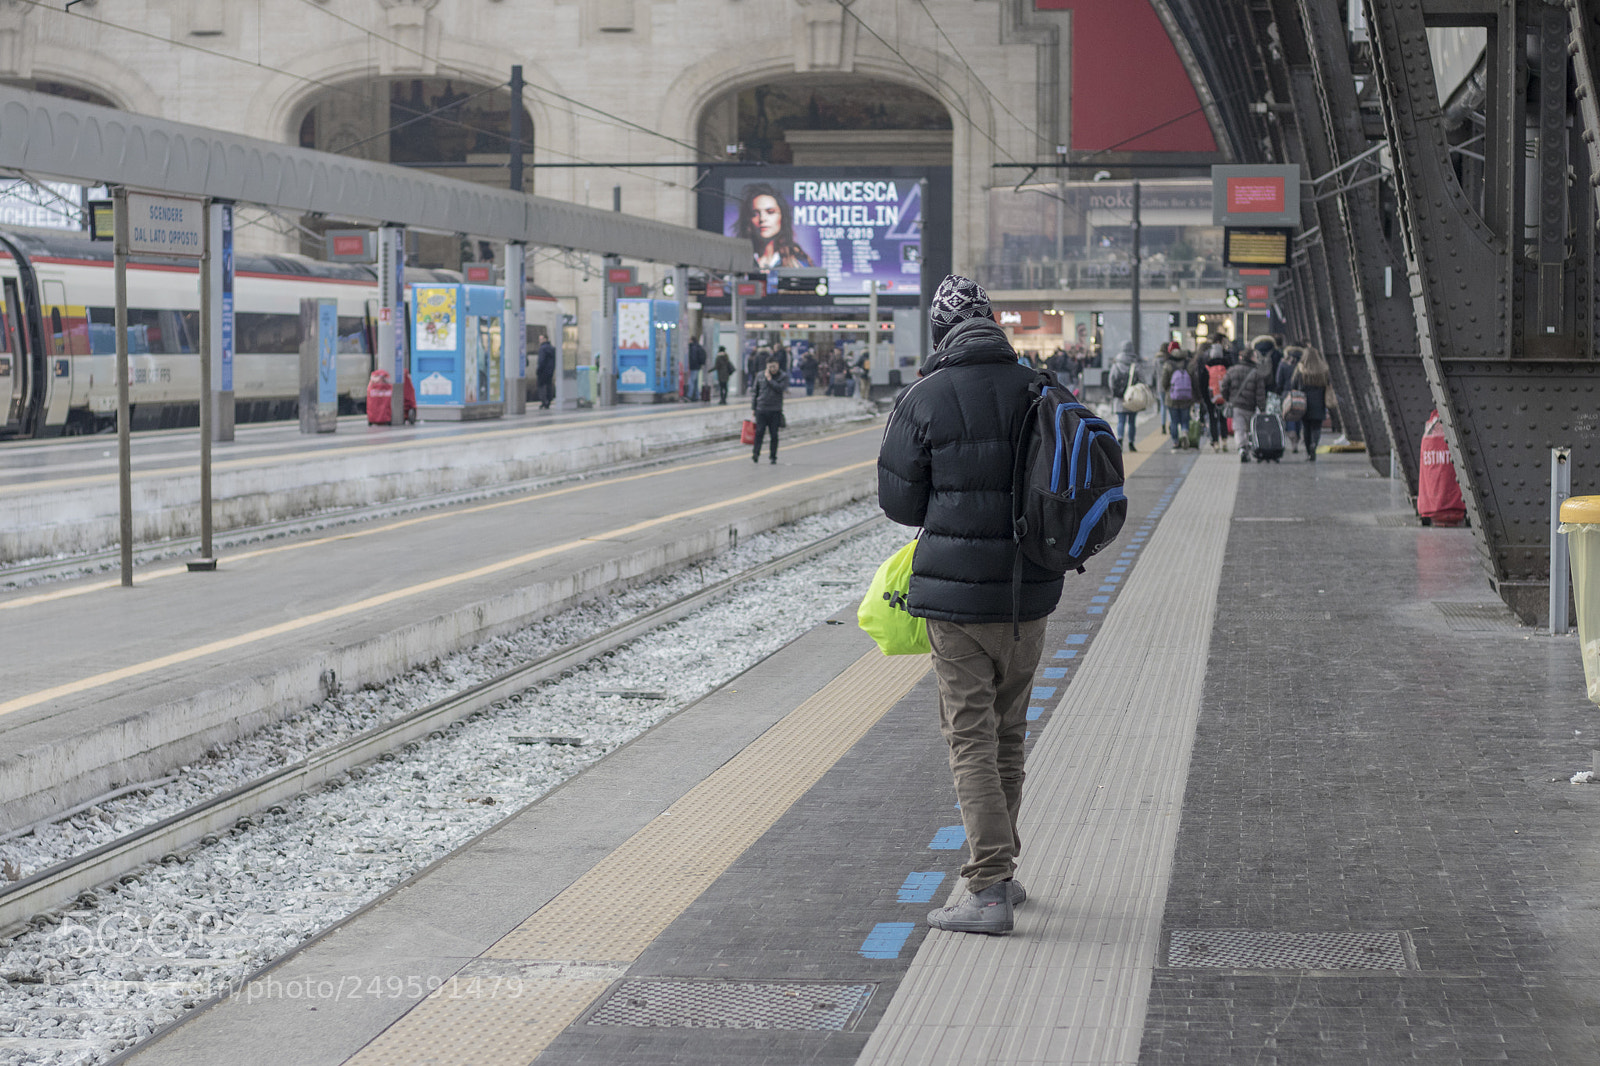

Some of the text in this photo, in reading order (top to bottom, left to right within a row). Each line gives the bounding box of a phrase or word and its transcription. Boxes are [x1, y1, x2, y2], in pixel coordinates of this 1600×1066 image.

[794, 181, 898, 202] FRANCESCA
[150, 205, 183, 222] SCENDERE
[794, 205, 898, 226] MICHIELIN
[135, 227, 198, 246] DAL LATO OPPOSTO
[818, 228, 874, 239] TOUR 2018
[1423, 450, 1451, 465] ESTINT
